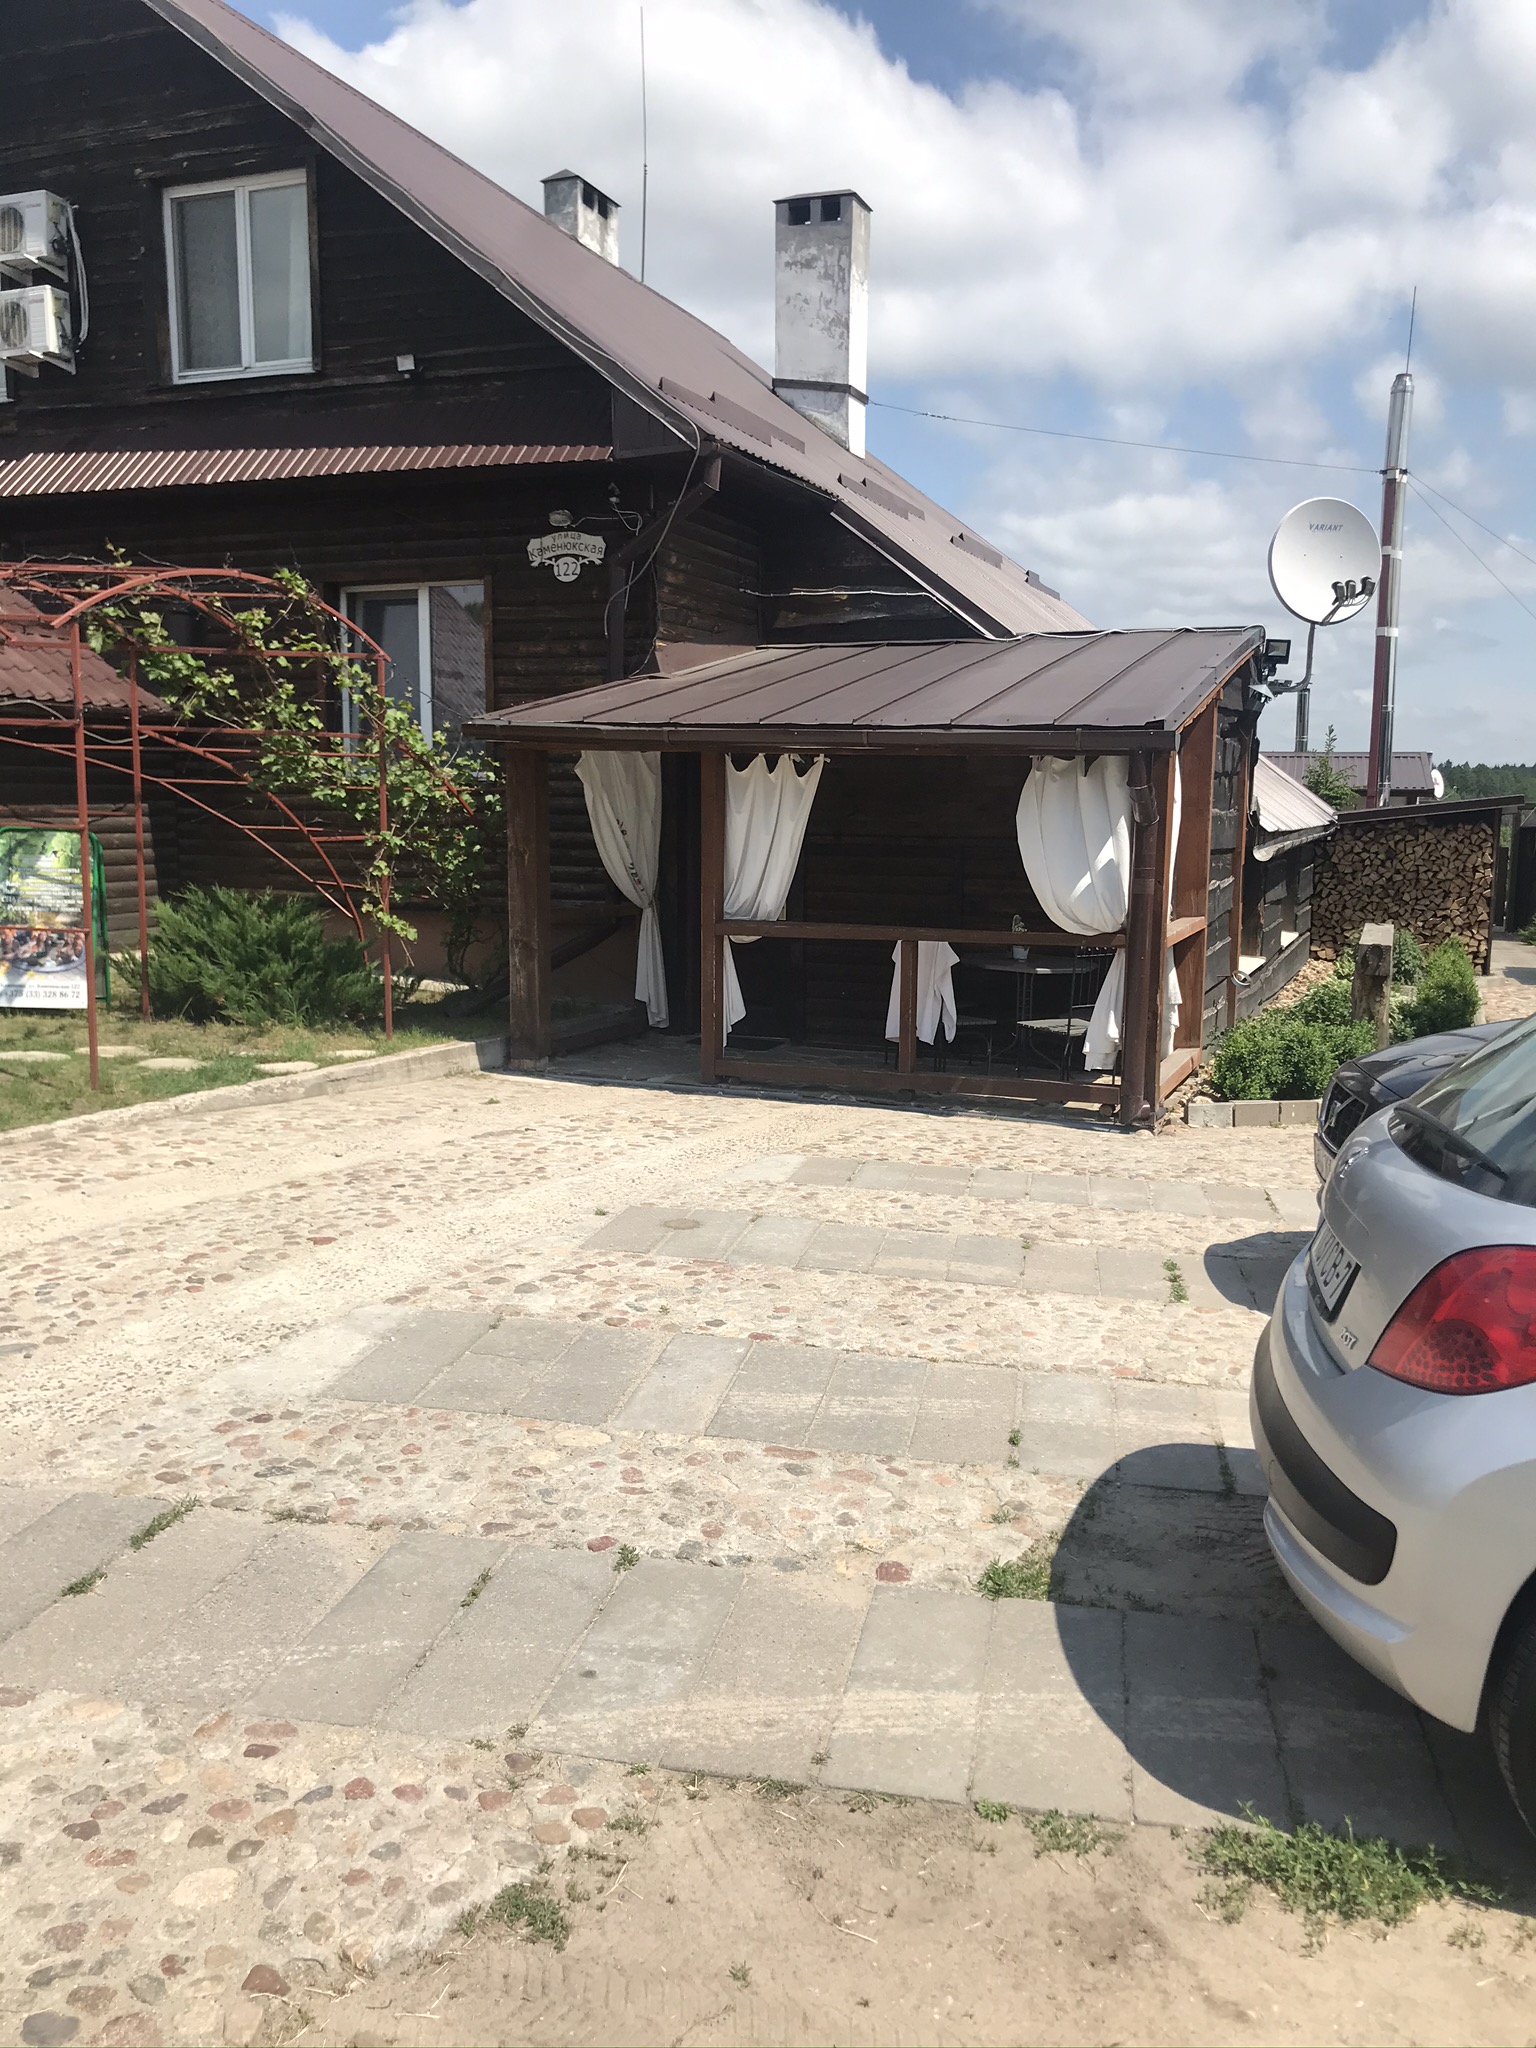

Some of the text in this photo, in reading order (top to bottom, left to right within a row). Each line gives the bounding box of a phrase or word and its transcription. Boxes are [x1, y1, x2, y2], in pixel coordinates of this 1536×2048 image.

[1308, 523, 1343, 532] VARIANT
[551, 532, 582, 543] улица
[529, 541, 604, 559] Каменюкская
[555, 562, 579, 577] 122
[25, 989, 41, 999] (33)
[42, 989, 57, 999] 328
[59, 990, 69, 999] 86
[71, 990, 80, 999] 72
